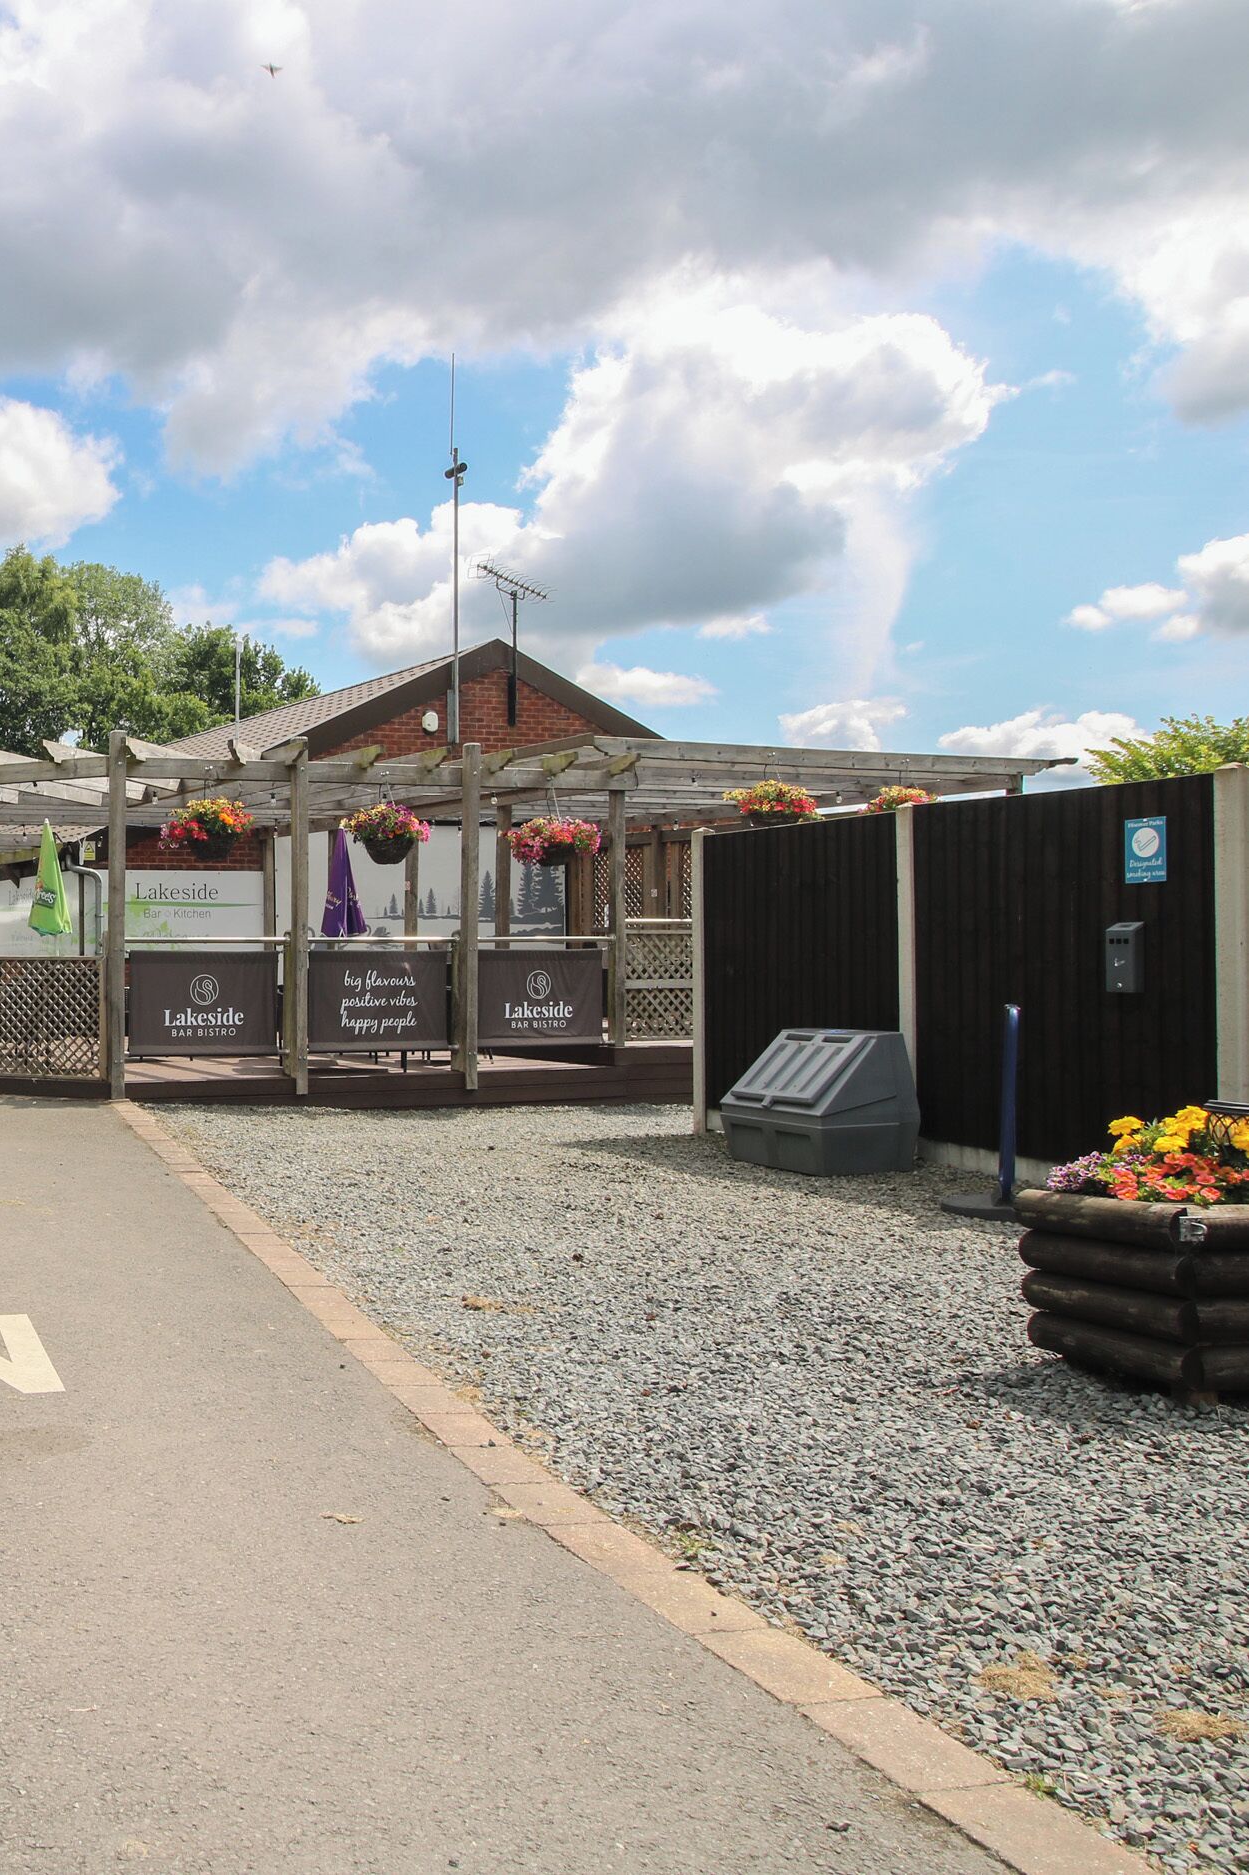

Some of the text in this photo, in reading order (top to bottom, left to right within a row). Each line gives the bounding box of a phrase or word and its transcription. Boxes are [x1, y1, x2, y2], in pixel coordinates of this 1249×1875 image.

[135, 882, 219, 901] Lakeside
[143, 908, 211, 919] Bar Kitchen
[344, 969, 416, 992] big flavours
[340, 989, 419, 1015] positive vibes
[504, 1001, 573, 1019] Lakeside
[163, 1007, 244, 1027] Lakeside
[341, 1010, 417, 1035] happy people
[511, 1019, 567, 1029] BAR BISTRO
[171, 1027, 237, 1037] BAR BISTRO
